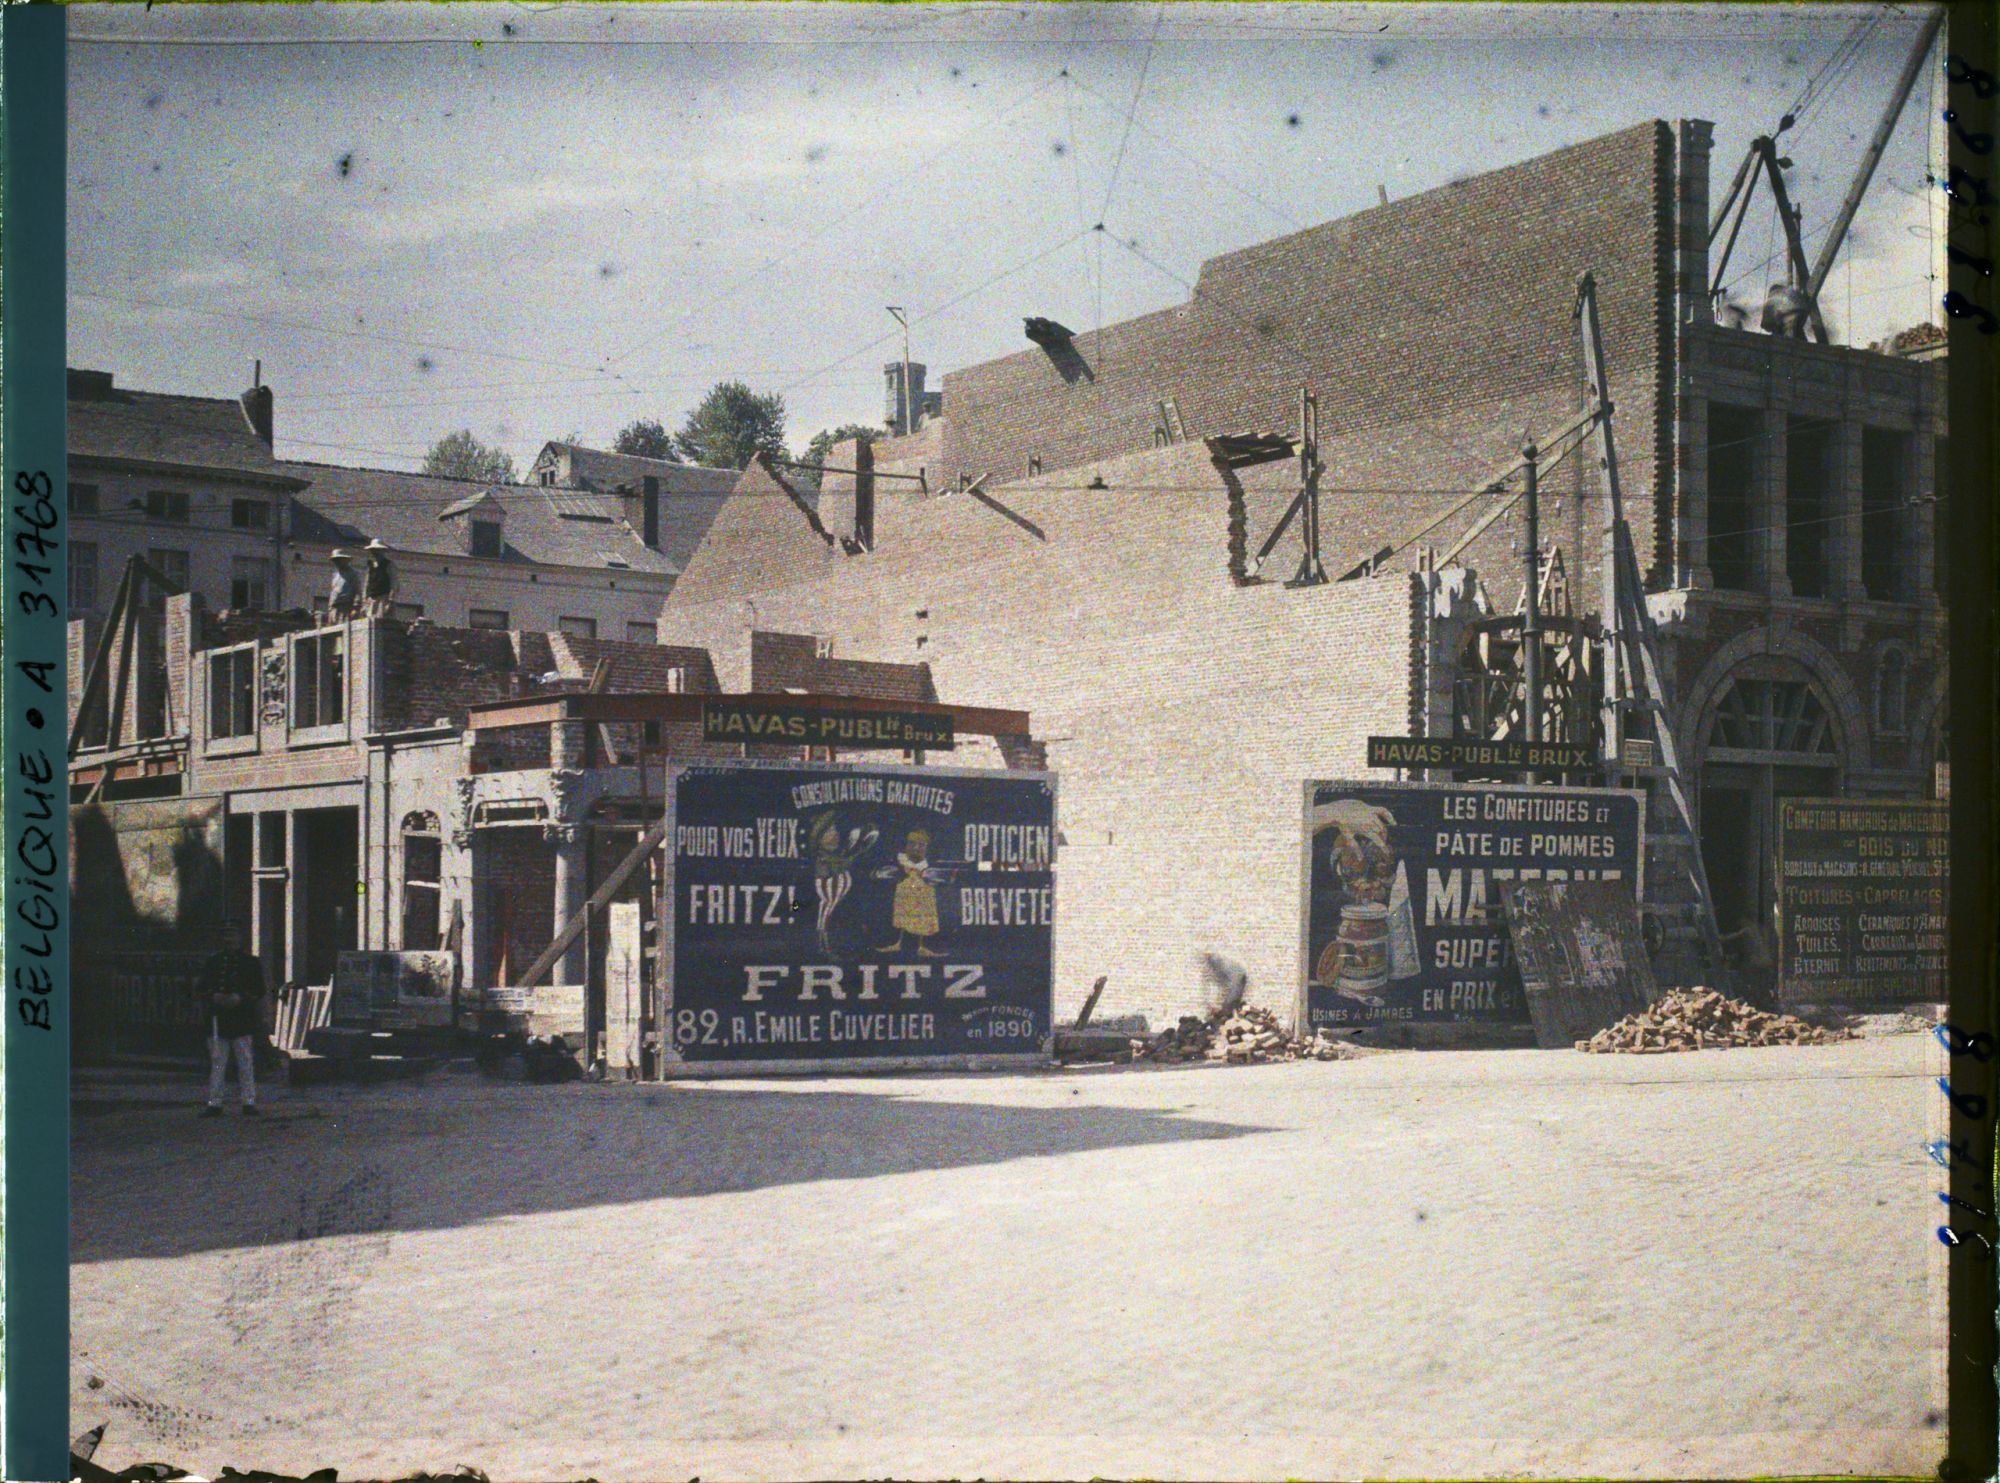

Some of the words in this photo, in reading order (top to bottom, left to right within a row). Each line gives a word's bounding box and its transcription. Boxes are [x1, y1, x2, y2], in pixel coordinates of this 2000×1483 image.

[16, 470, 59, 617] 31768
[22, 661, 57, 693] A
[791, 778, 883, 809] CONSULTATIONS
[886, 780, 955, 815] GRATUITES
[1444, 797, 1477, 820] LES
[1484, 793, 1590, 823] CONFITURES
[1595, 807, 1611, 821] ET
[677, 826, 718, 857] POUR
[723, 827, 754, 858] VOS
[964, 823, 1051, 864] OPTICIEN
[1500, 837, 1523, 856] DE
[1530, 833, 1615, 857] POMMES
[1859, 837, 1893, 858] BOIS
[1786, 885, 1853, 908] TOITURES
[741, 964, 987, 1001] FRITZ
[1423, 988, 1445, 1011] EN
[1450, 981, 1498, 1010] PRIX
[829, 1009, 935, 1040] CUVELIER
[988, 1020, 1033, 1038] 1890
[1312, 1007, 1349, 1022] USINES
